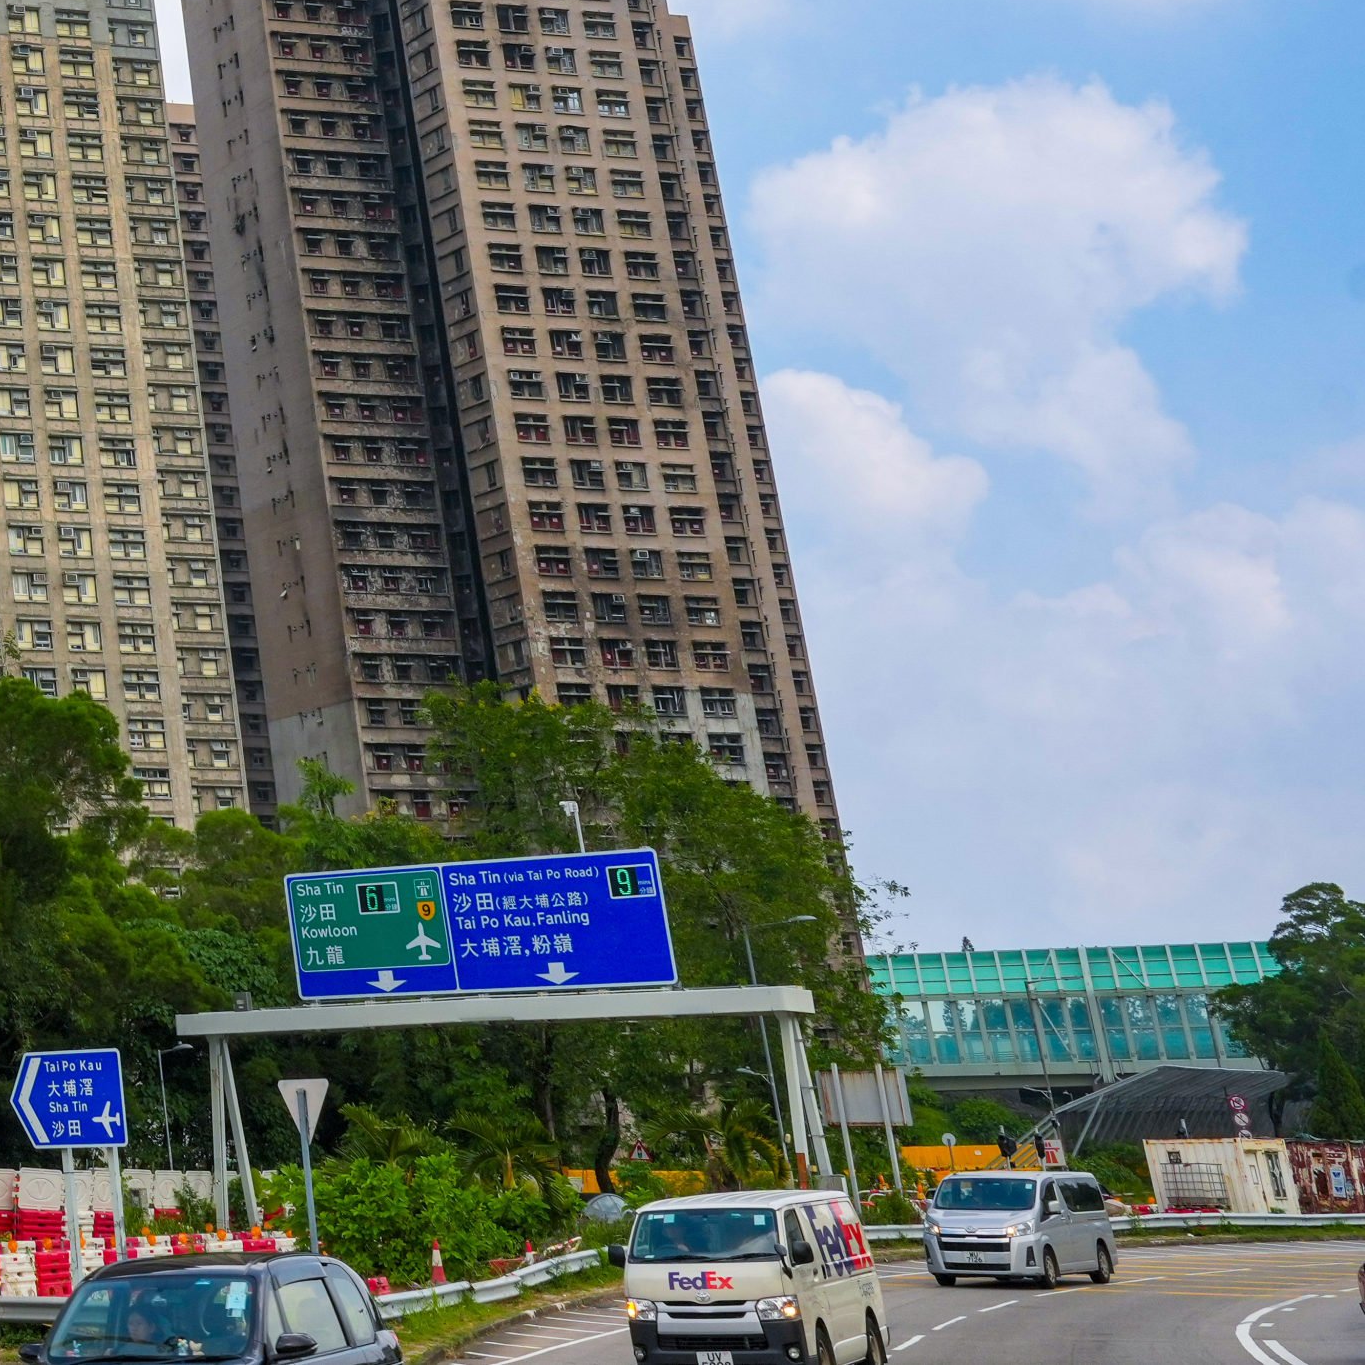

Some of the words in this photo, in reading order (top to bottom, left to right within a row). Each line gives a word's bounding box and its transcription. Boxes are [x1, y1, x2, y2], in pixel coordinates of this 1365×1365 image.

[449, 872, 476, 886] Sha
[479, 870, 501, 884] Tin
[503, 870, 524, 884] (via
[526, 869, 543, 881] Tai
[546, 869, 561, 880] Po
[564, 866, 599, 879] Road)
[616, 868, 631, 895] 9
[296, 884, 322, 897] Sha
[323, 881, 344, 895] Tin
[365, 886, 379, 911] 6
[300, 903, 336, 923] 沙田
[421, 903, 431, 916] 9
[301, 924, 358, 939] Kowloon
[455, 916, 476, 930] Tai
[481, 915, 499, 929] Po
[306, 945, 346, 966] 九龍
[43, 1061, 60, 1073] Tai
[62, 1060, 76, 1072] Po
[79, 1059, 102, 1071] Kau
[47, 1078, 94, 1097] 大埔滘
[49, 1101, 69, 1113] Sha
[72, 1100, 88, 1112] Tin
[52, 1119, 82, 1138] 沙田
[802, 1198, 875, 1278] FedEx
[668, 1271, 734, 1290] FedEx
[706, 1352, 722, 1362] UV
